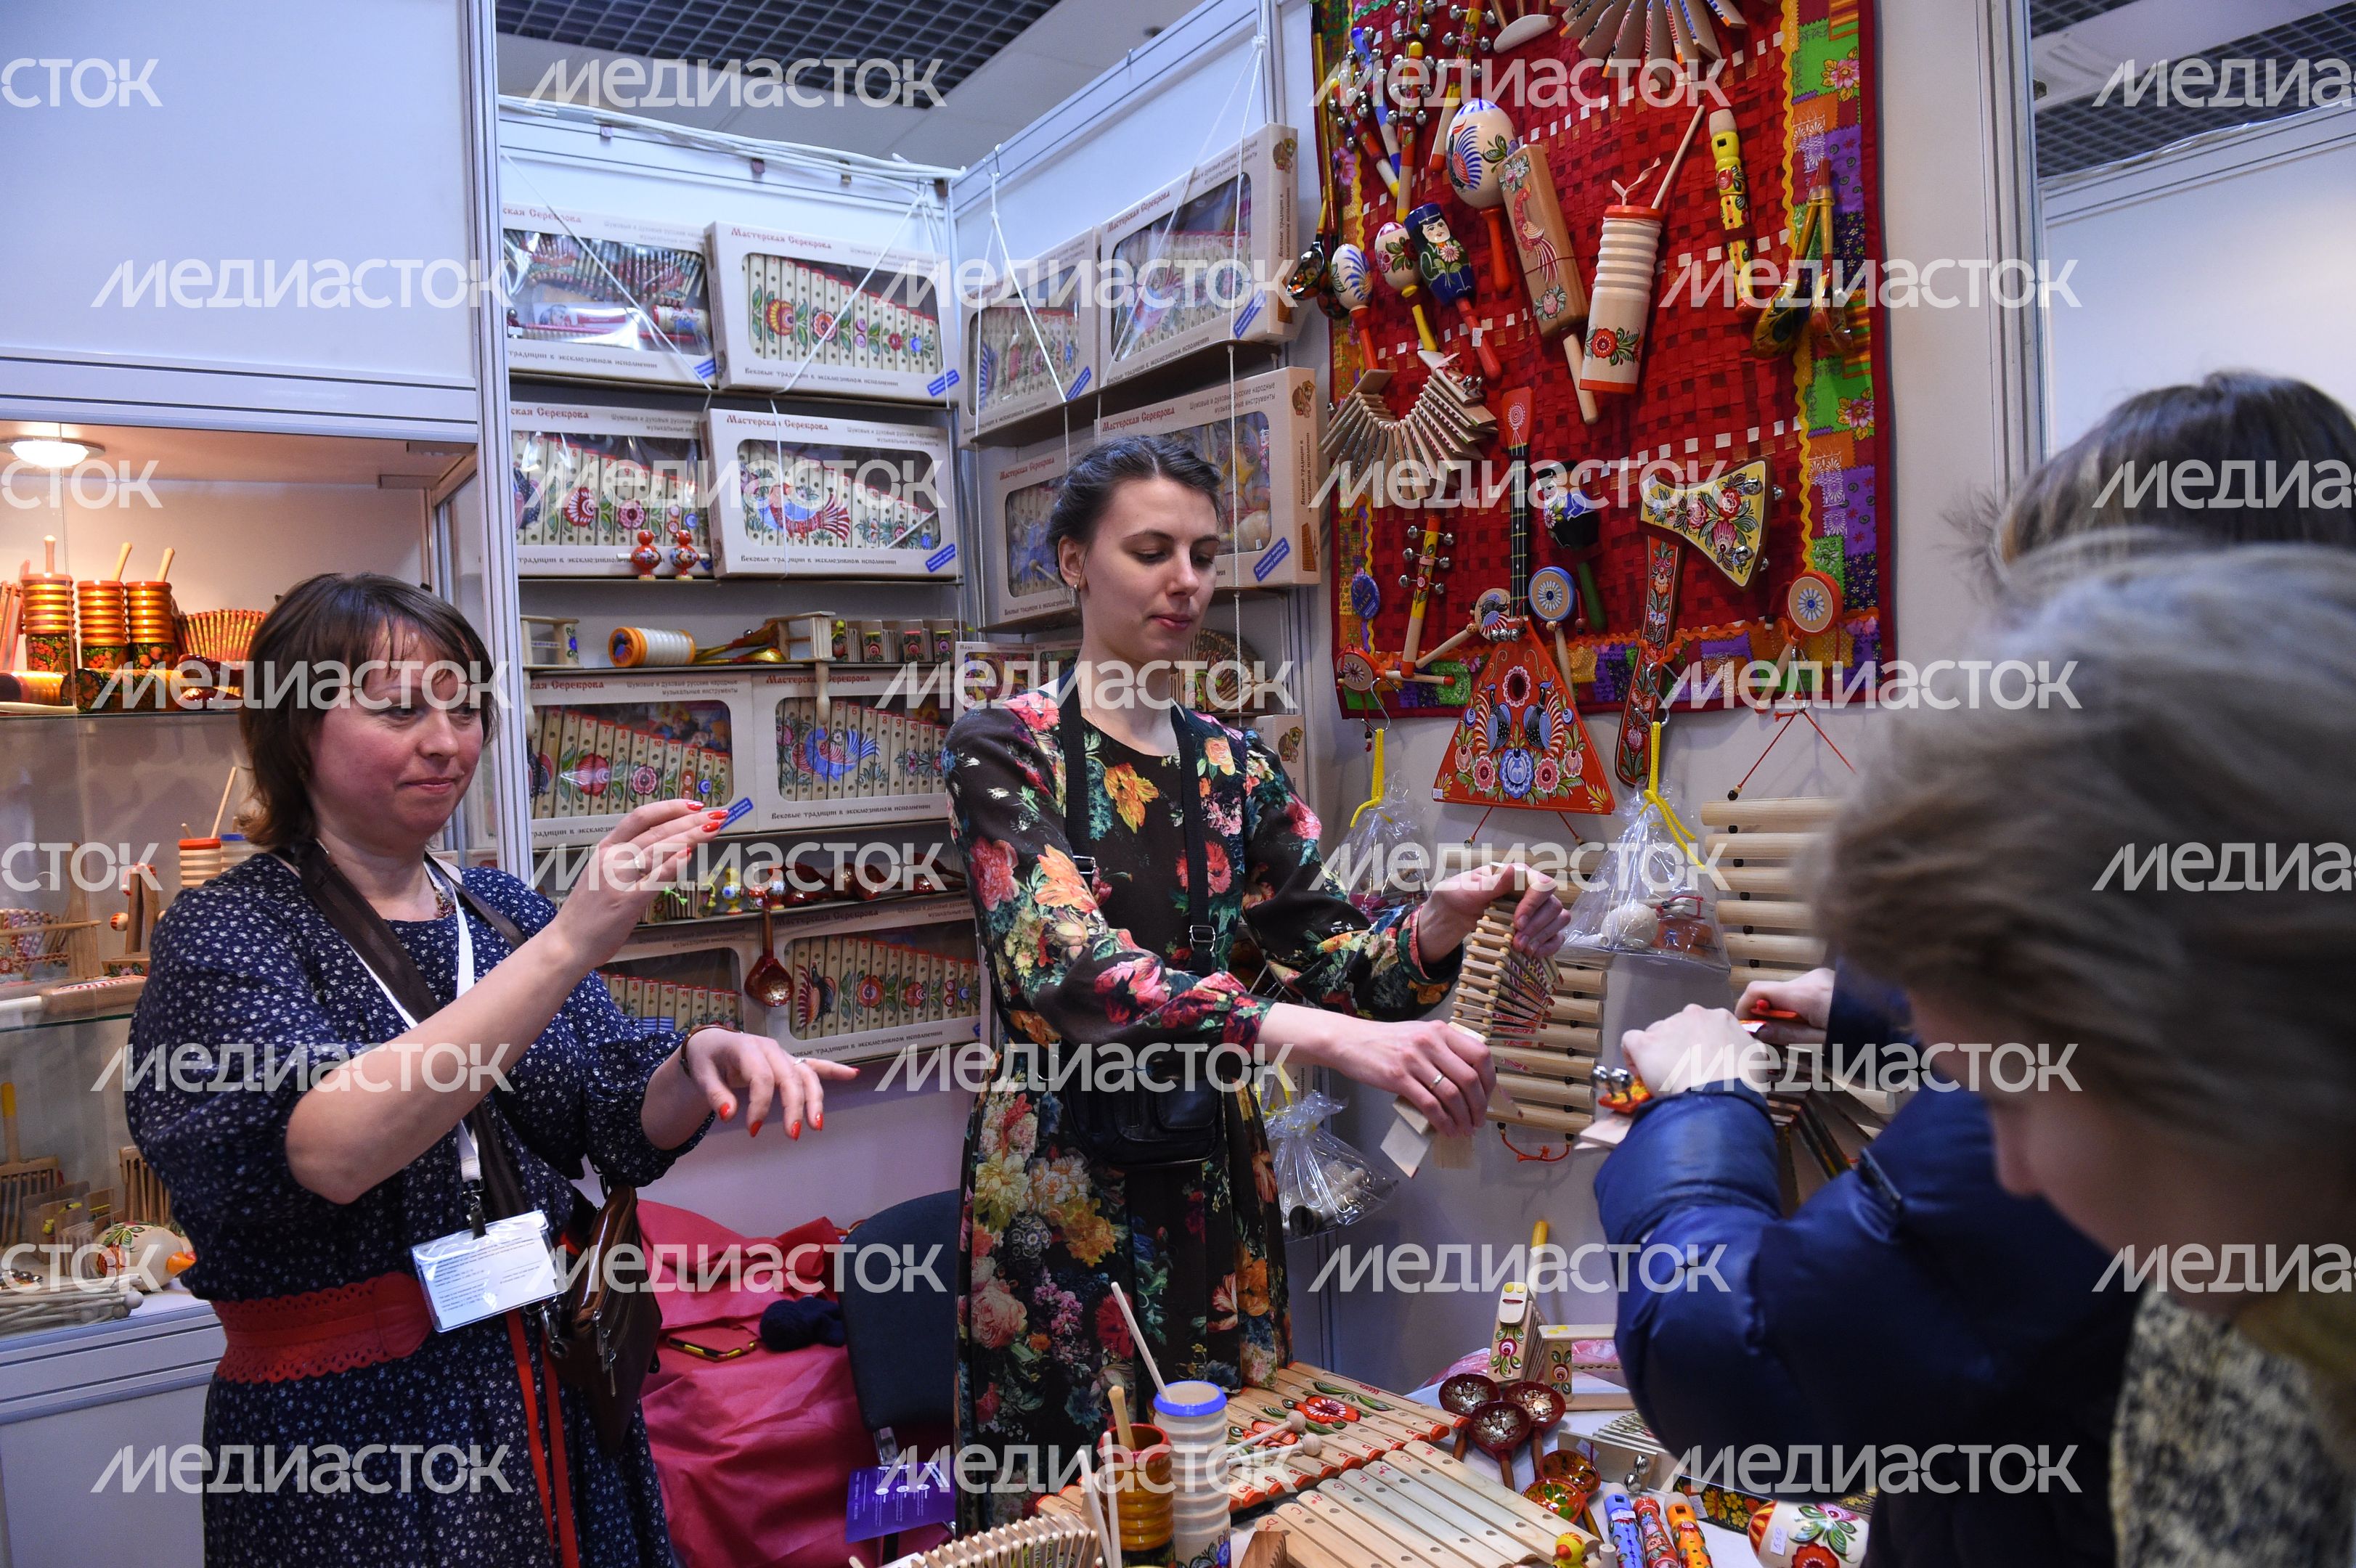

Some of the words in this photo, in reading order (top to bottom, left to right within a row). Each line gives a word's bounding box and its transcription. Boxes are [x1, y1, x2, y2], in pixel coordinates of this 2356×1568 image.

[731, 228, 785, 243] Мастерская
[1103, 416, 1140, 432] Мастерская
[766, 674, 816, 685] Мастерска
